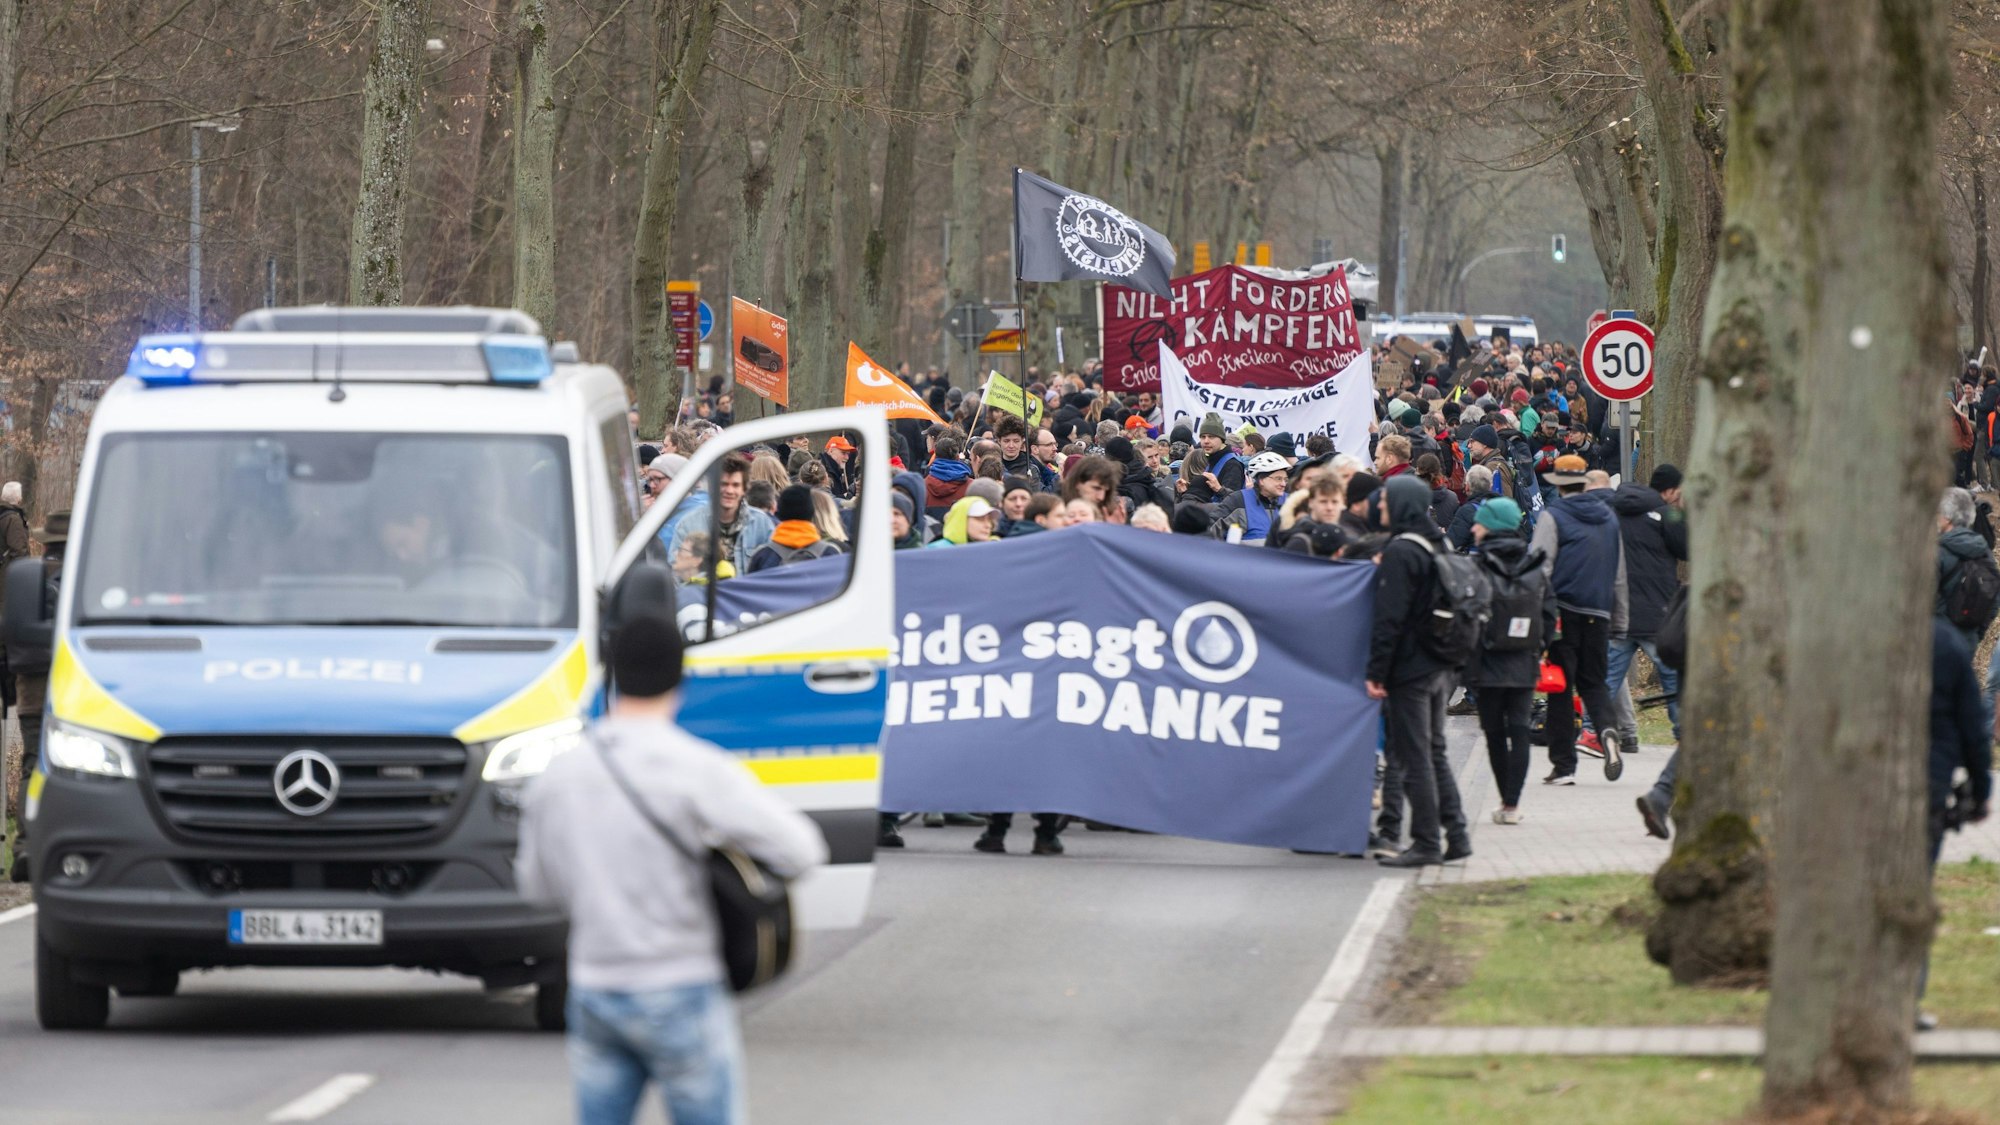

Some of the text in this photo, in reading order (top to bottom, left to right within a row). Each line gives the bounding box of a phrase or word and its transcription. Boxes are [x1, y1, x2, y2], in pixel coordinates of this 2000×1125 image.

[1231, 273, 1348, 311] FORDERN
[771, 321, 786, 332] ödp
[1184, 306, 1355, 351] KÄMPFEN!
[1602, 342, 1645, 378] 50
[1259, 379, 1339, 412] CHANGE
[1242, 414, 1280, 428] NOT
[1021, 618, 1167, 679] sagt
[204, 657, 423, 684] POLIZEI
[1056, 672, 1283, 751] DANKE
[322, 915, 376, 939] 3142
